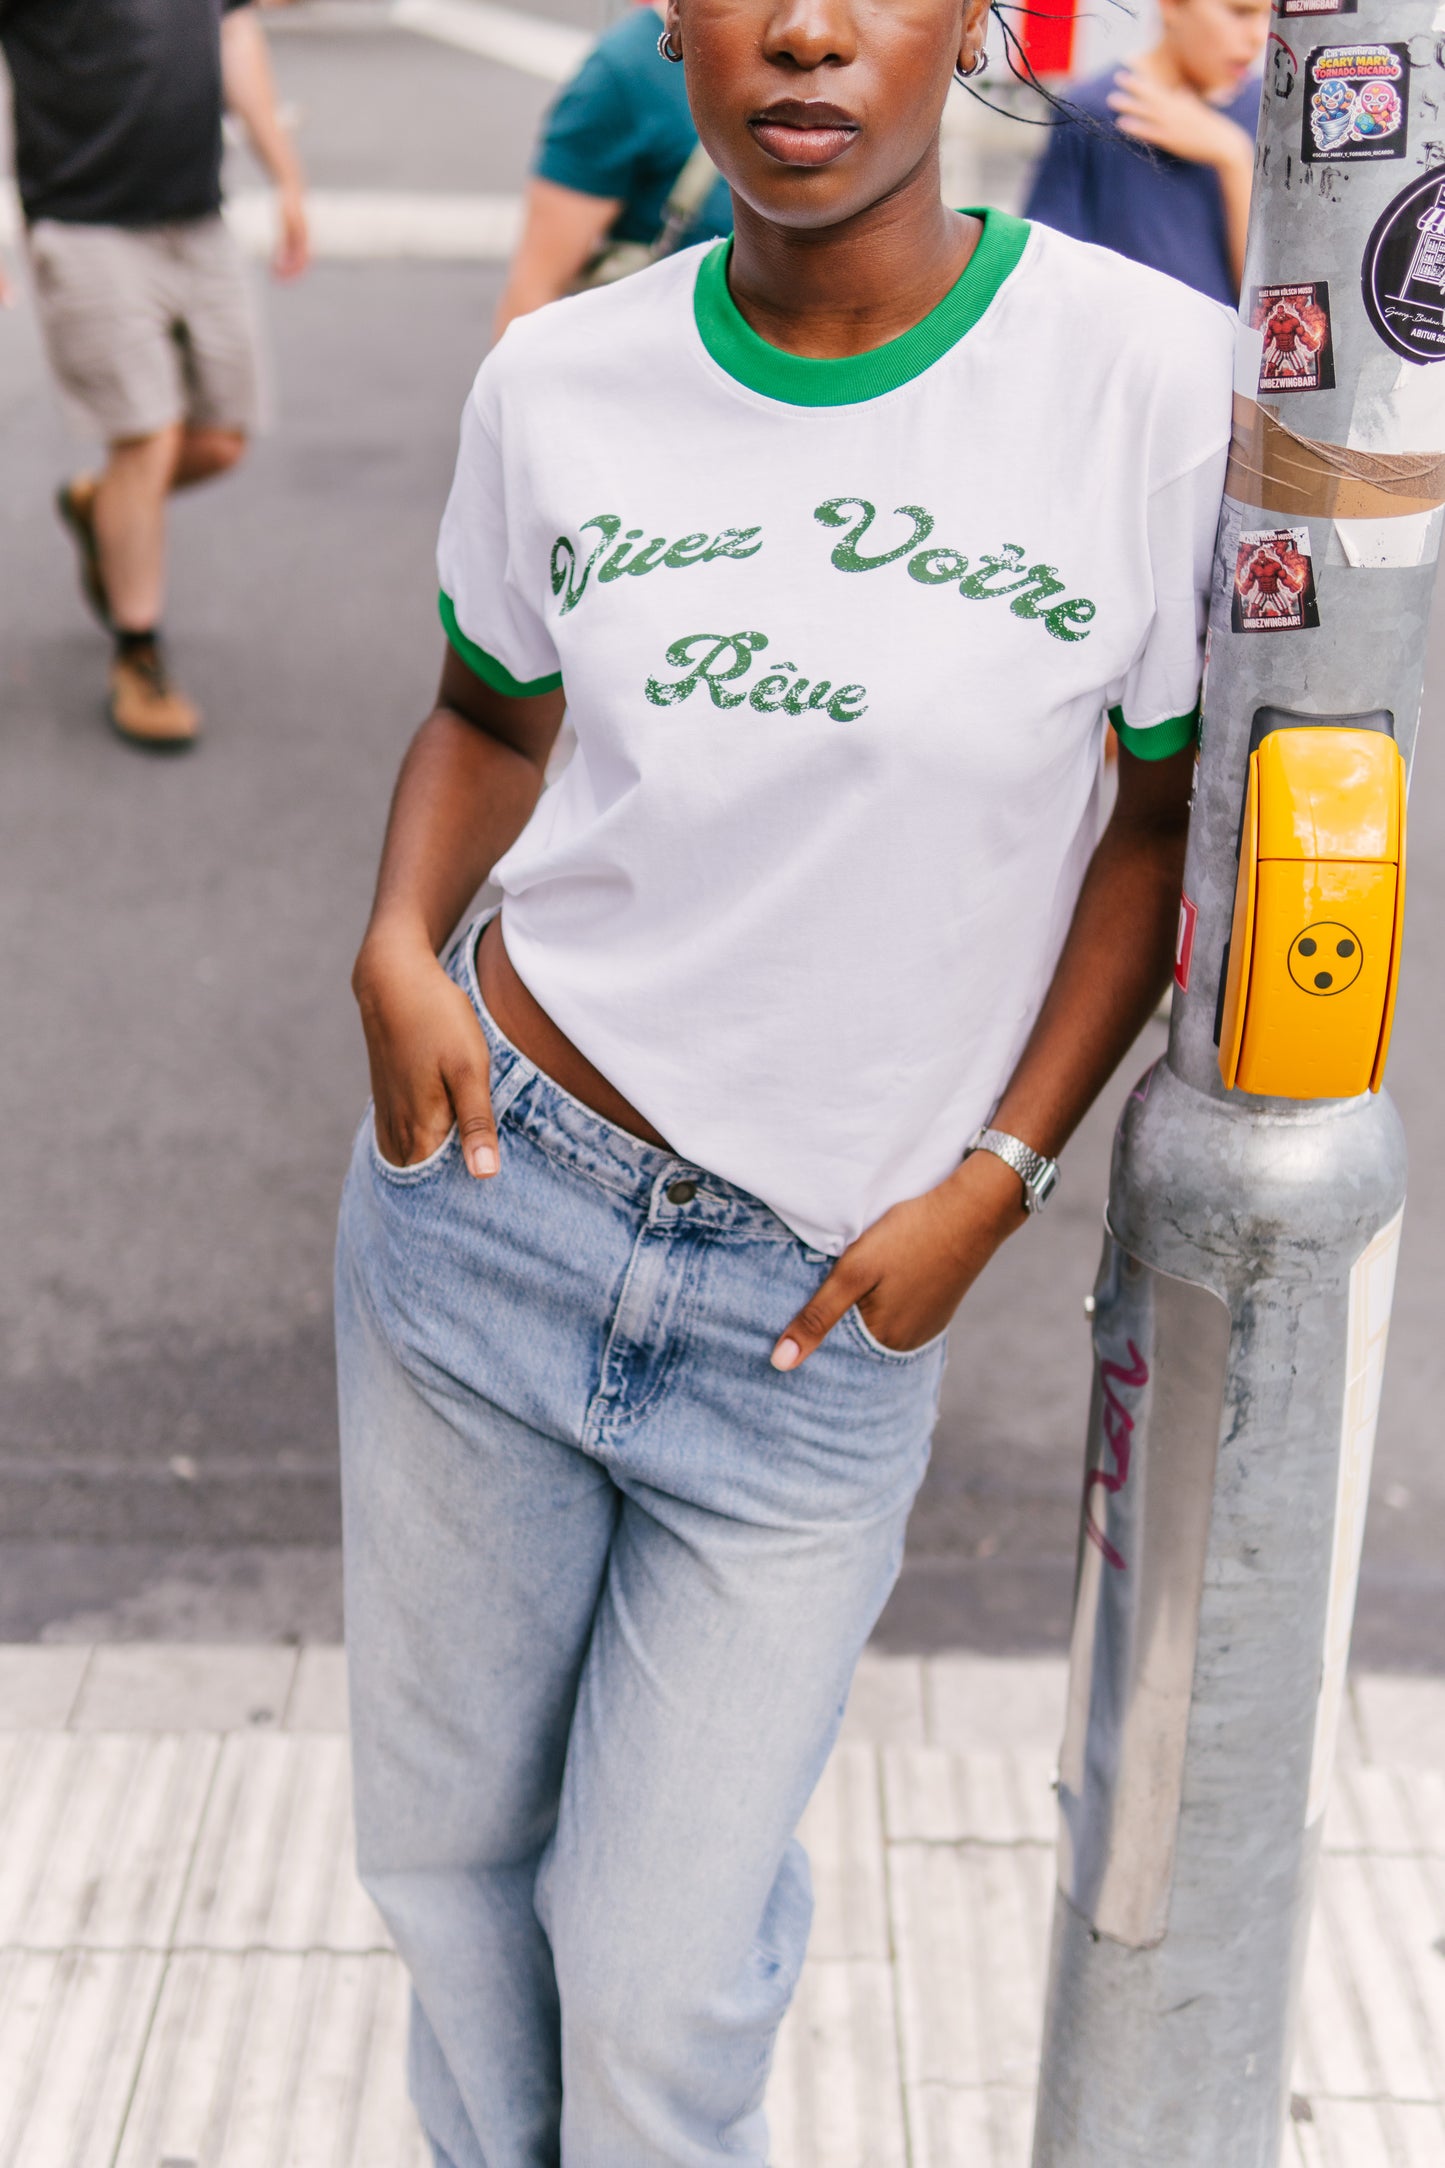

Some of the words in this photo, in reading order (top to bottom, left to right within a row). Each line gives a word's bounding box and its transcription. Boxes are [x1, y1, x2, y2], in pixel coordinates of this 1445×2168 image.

[1319, 57, 1354, 69] SCARY
[1355, 55, 1389, 67] MARY
[1314, 67, 1356, 79] TORNADO
[1356, 65, 1398, 77] RICARDO
[1410, 328, 1437, 341] ABITUR
[1259, 376, 1317, 389] UNBEZWINGBAR!
[1243, 615, 1301, 629] UNBEZWINGBAR!
[645, 631, 869, 722] Rêve
